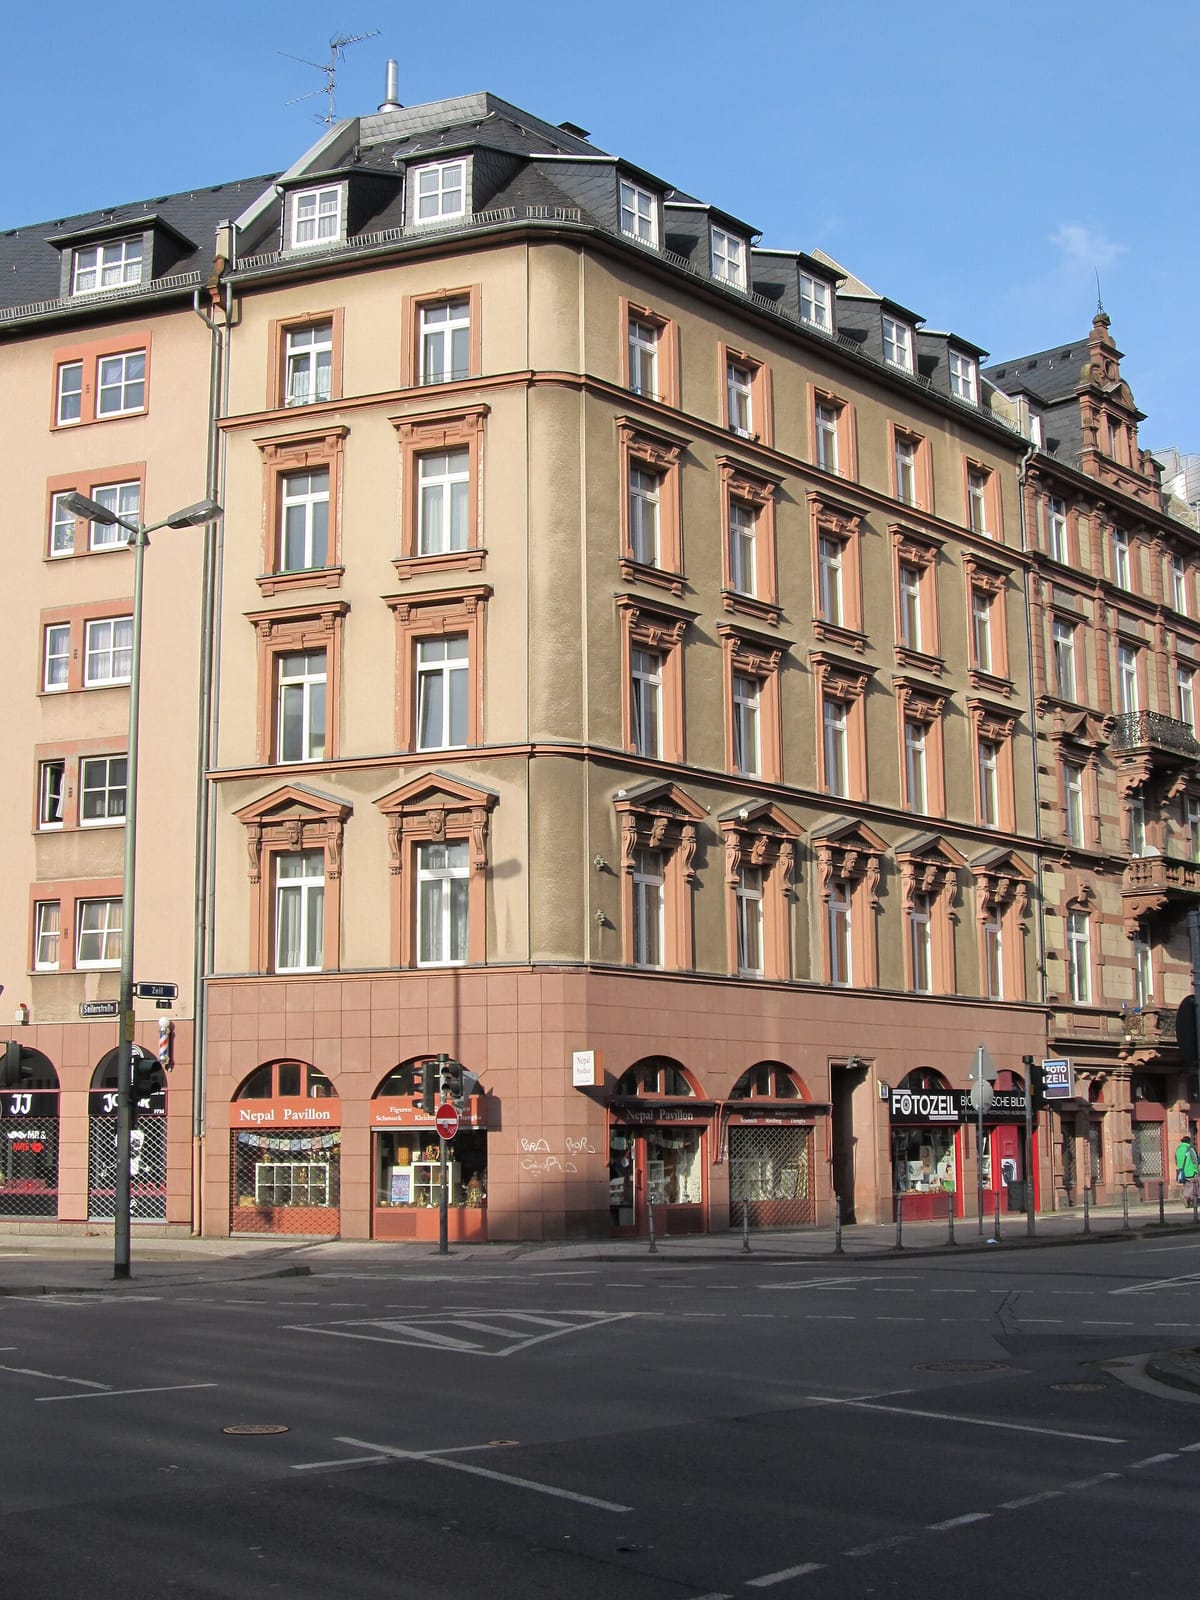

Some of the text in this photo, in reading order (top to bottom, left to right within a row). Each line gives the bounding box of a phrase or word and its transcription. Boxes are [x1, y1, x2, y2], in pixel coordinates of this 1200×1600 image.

[151, 986, 164, 995] Zeil
[1046, 1065, 1067, 1073] FOTO
[1046, 1074, 1068, 1083] ZEIL
[10, 1093, 33, 1115] JJ
[892, 1094, 958, 1115] FOTOZEIL
[239, 1108, 331, 1125] Nepal Pavillon
[626, 1109, 694, 1124] Nepal Pavillon
